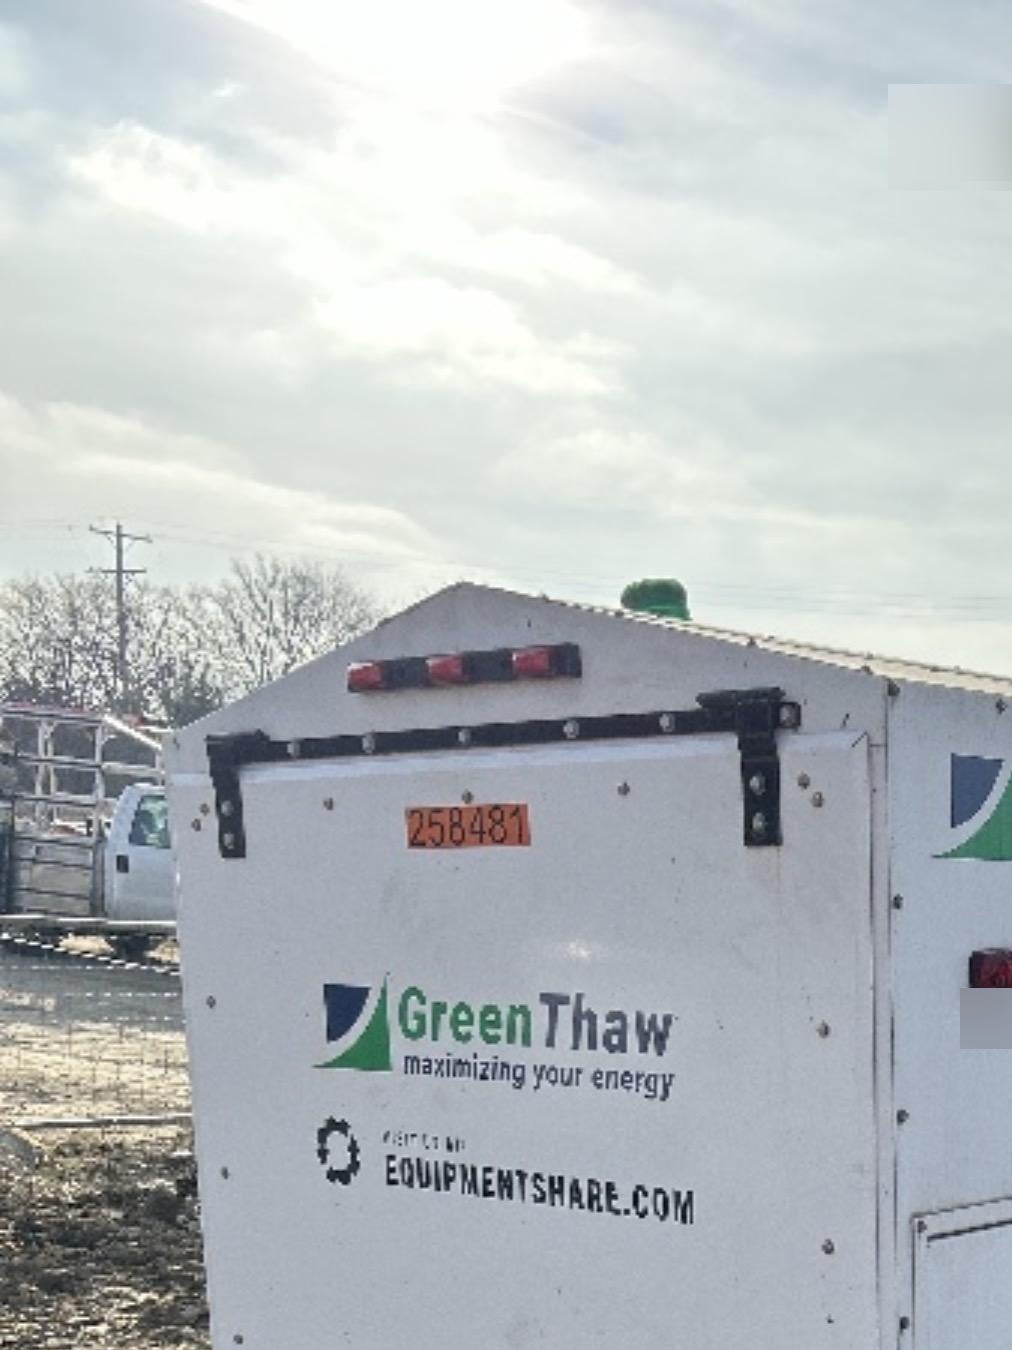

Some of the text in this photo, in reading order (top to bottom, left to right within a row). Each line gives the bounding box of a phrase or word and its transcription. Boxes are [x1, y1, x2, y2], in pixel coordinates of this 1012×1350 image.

[409, 804, 524, 847] 258481
[404, 1053, 676, 1102] maximizing your energy
[385, 1154, 695, 1225] EQUIPMENTSHARE.COM
